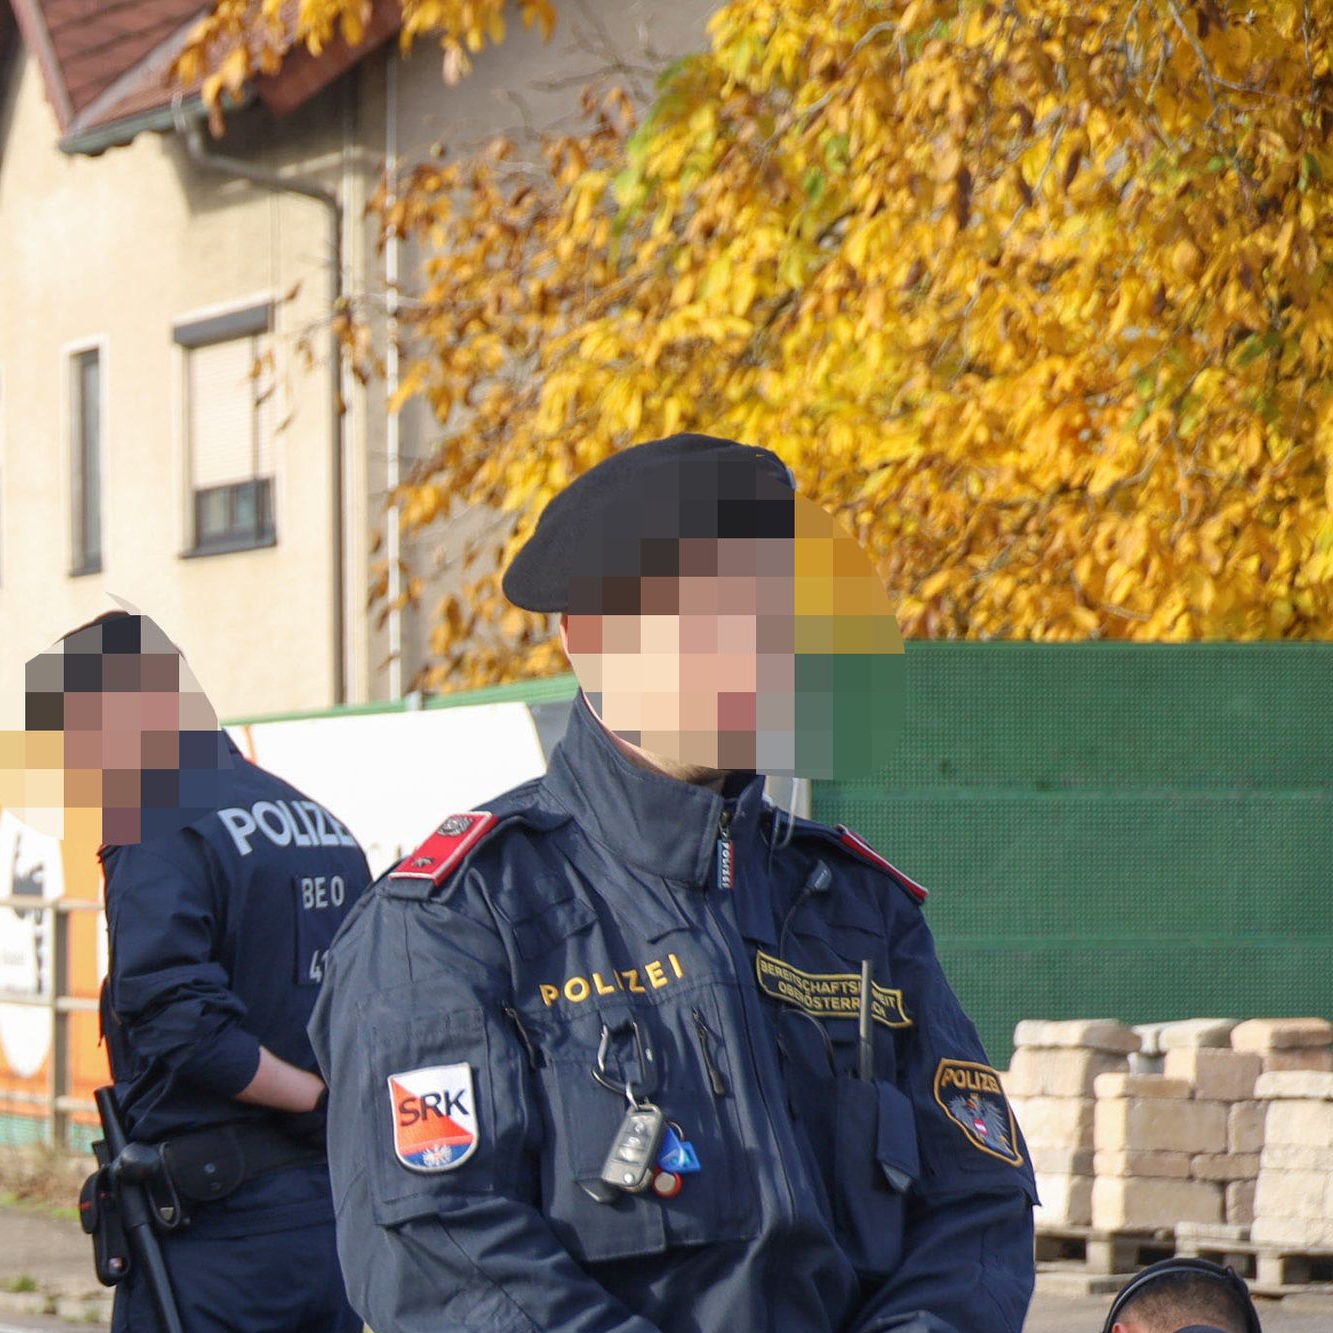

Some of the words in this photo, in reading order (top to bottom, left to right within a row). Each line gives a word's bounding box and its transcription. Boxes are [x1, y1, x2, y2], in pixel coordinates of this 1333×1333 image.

[301, 876, 329, 910] BE
[539, 952, 684, 1008] POLIZEI
[398, 1087, 470, 1128] SRK
